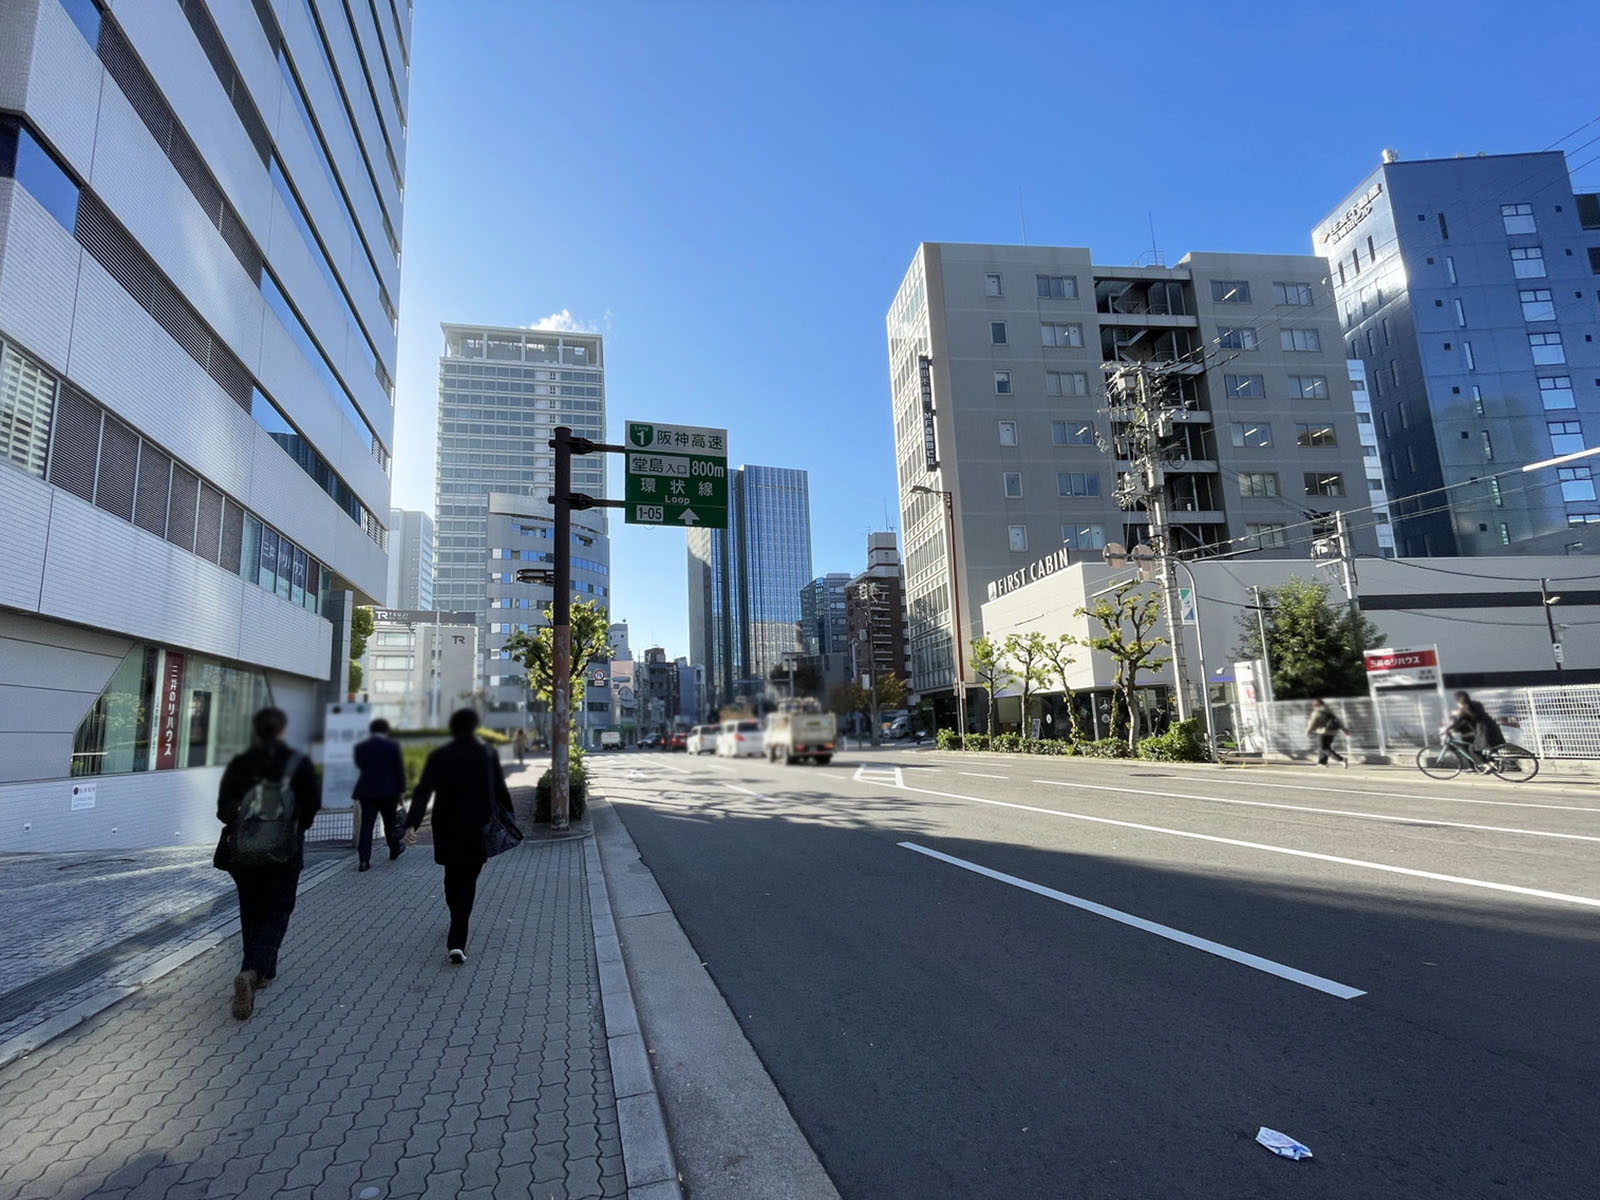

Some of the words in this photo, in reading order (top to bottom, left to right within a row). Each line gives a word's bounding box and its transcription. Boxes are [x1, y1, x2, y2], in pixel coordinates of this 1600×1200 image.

[636, 430, 645, 446] 1
[657, 430, 723, 450] 阪神高速
[632, 457, 688, 474] 堂島入口
[691, 460, 724, 477] 800m
[640, 477, 714, 497] 環状線
[665, 495, 690, 505] Loop
[638, 507, 662, 520] 1-05
[997, 567, 1026, 596] FIRST
[1030, 547, 1069, 581] CABIN
[452, 635, 466, 645] TR
[1370, 656, 1420, 668] 三井のリハウス
[164, 665, 179, 756] 三井のリハウス
